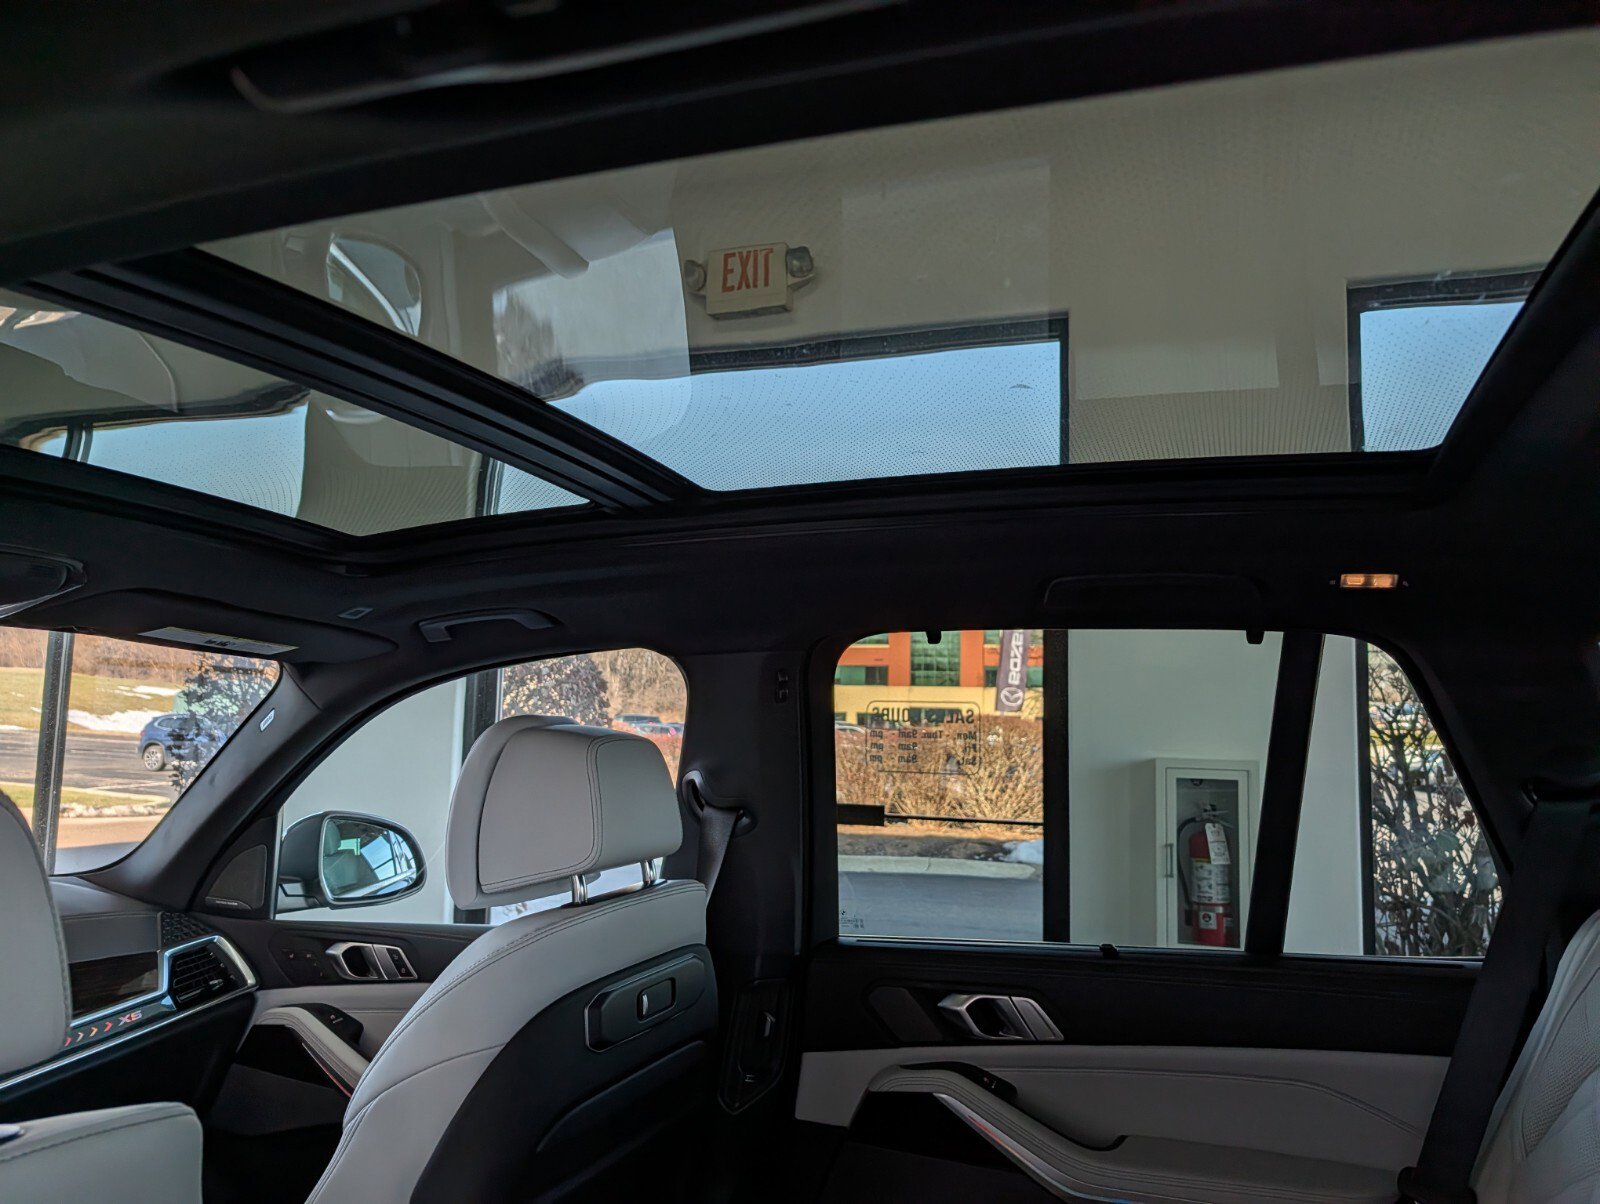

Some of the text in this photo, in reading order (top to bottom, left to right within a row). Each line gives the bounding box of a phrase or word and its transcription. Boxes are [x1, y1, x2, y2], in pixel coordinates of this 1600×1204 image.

[721, 248, 774, 293] EXIT
[1008, 630, 1024, 685] azda
[118, 1010, 143, 1026] X5
